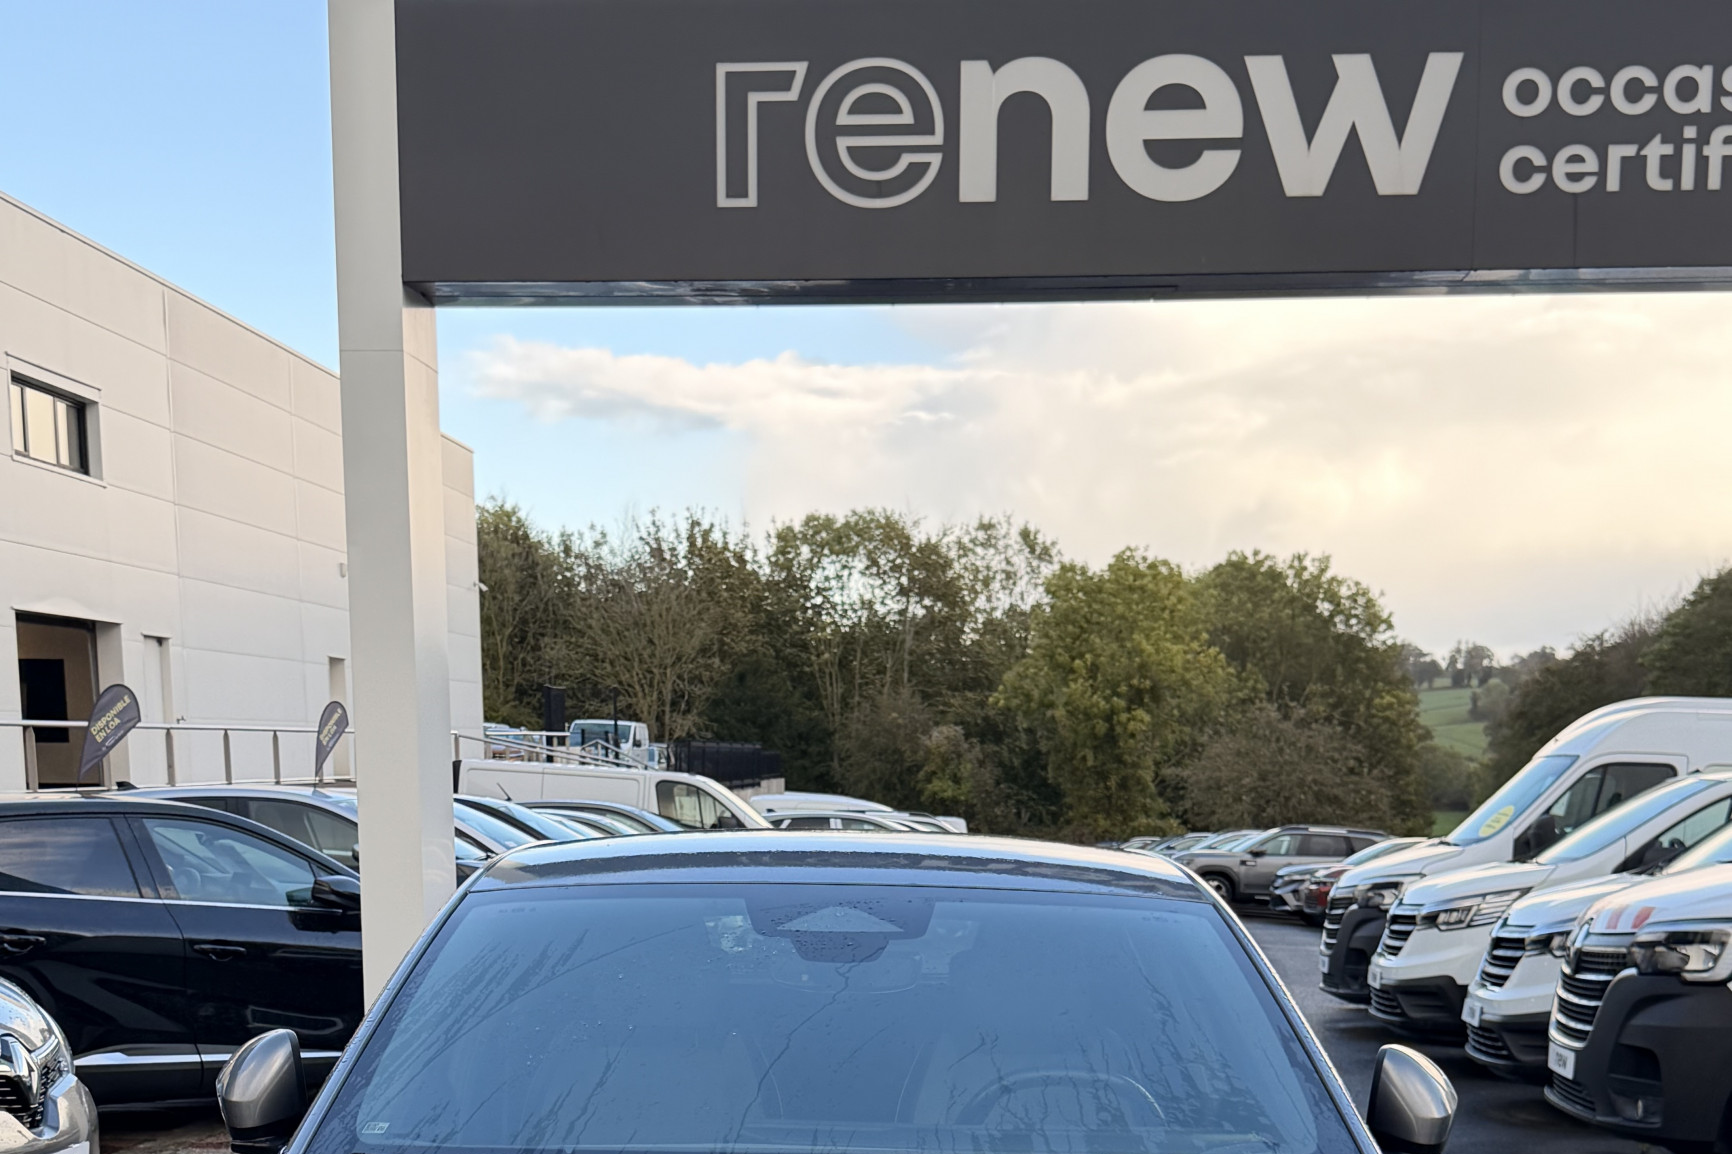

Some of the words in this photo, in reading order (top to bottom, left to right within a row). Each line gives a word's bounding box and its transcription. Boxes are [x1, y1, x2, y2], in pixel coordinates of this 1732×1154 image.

[1502, 64, 1732, 117] occa
[715, 53, 1464, 208] renew
[90, 695, 131, 735] DISPONIBLE
[95, 729, 107, 743] EN
[105, 717, 121, 734] LOA
